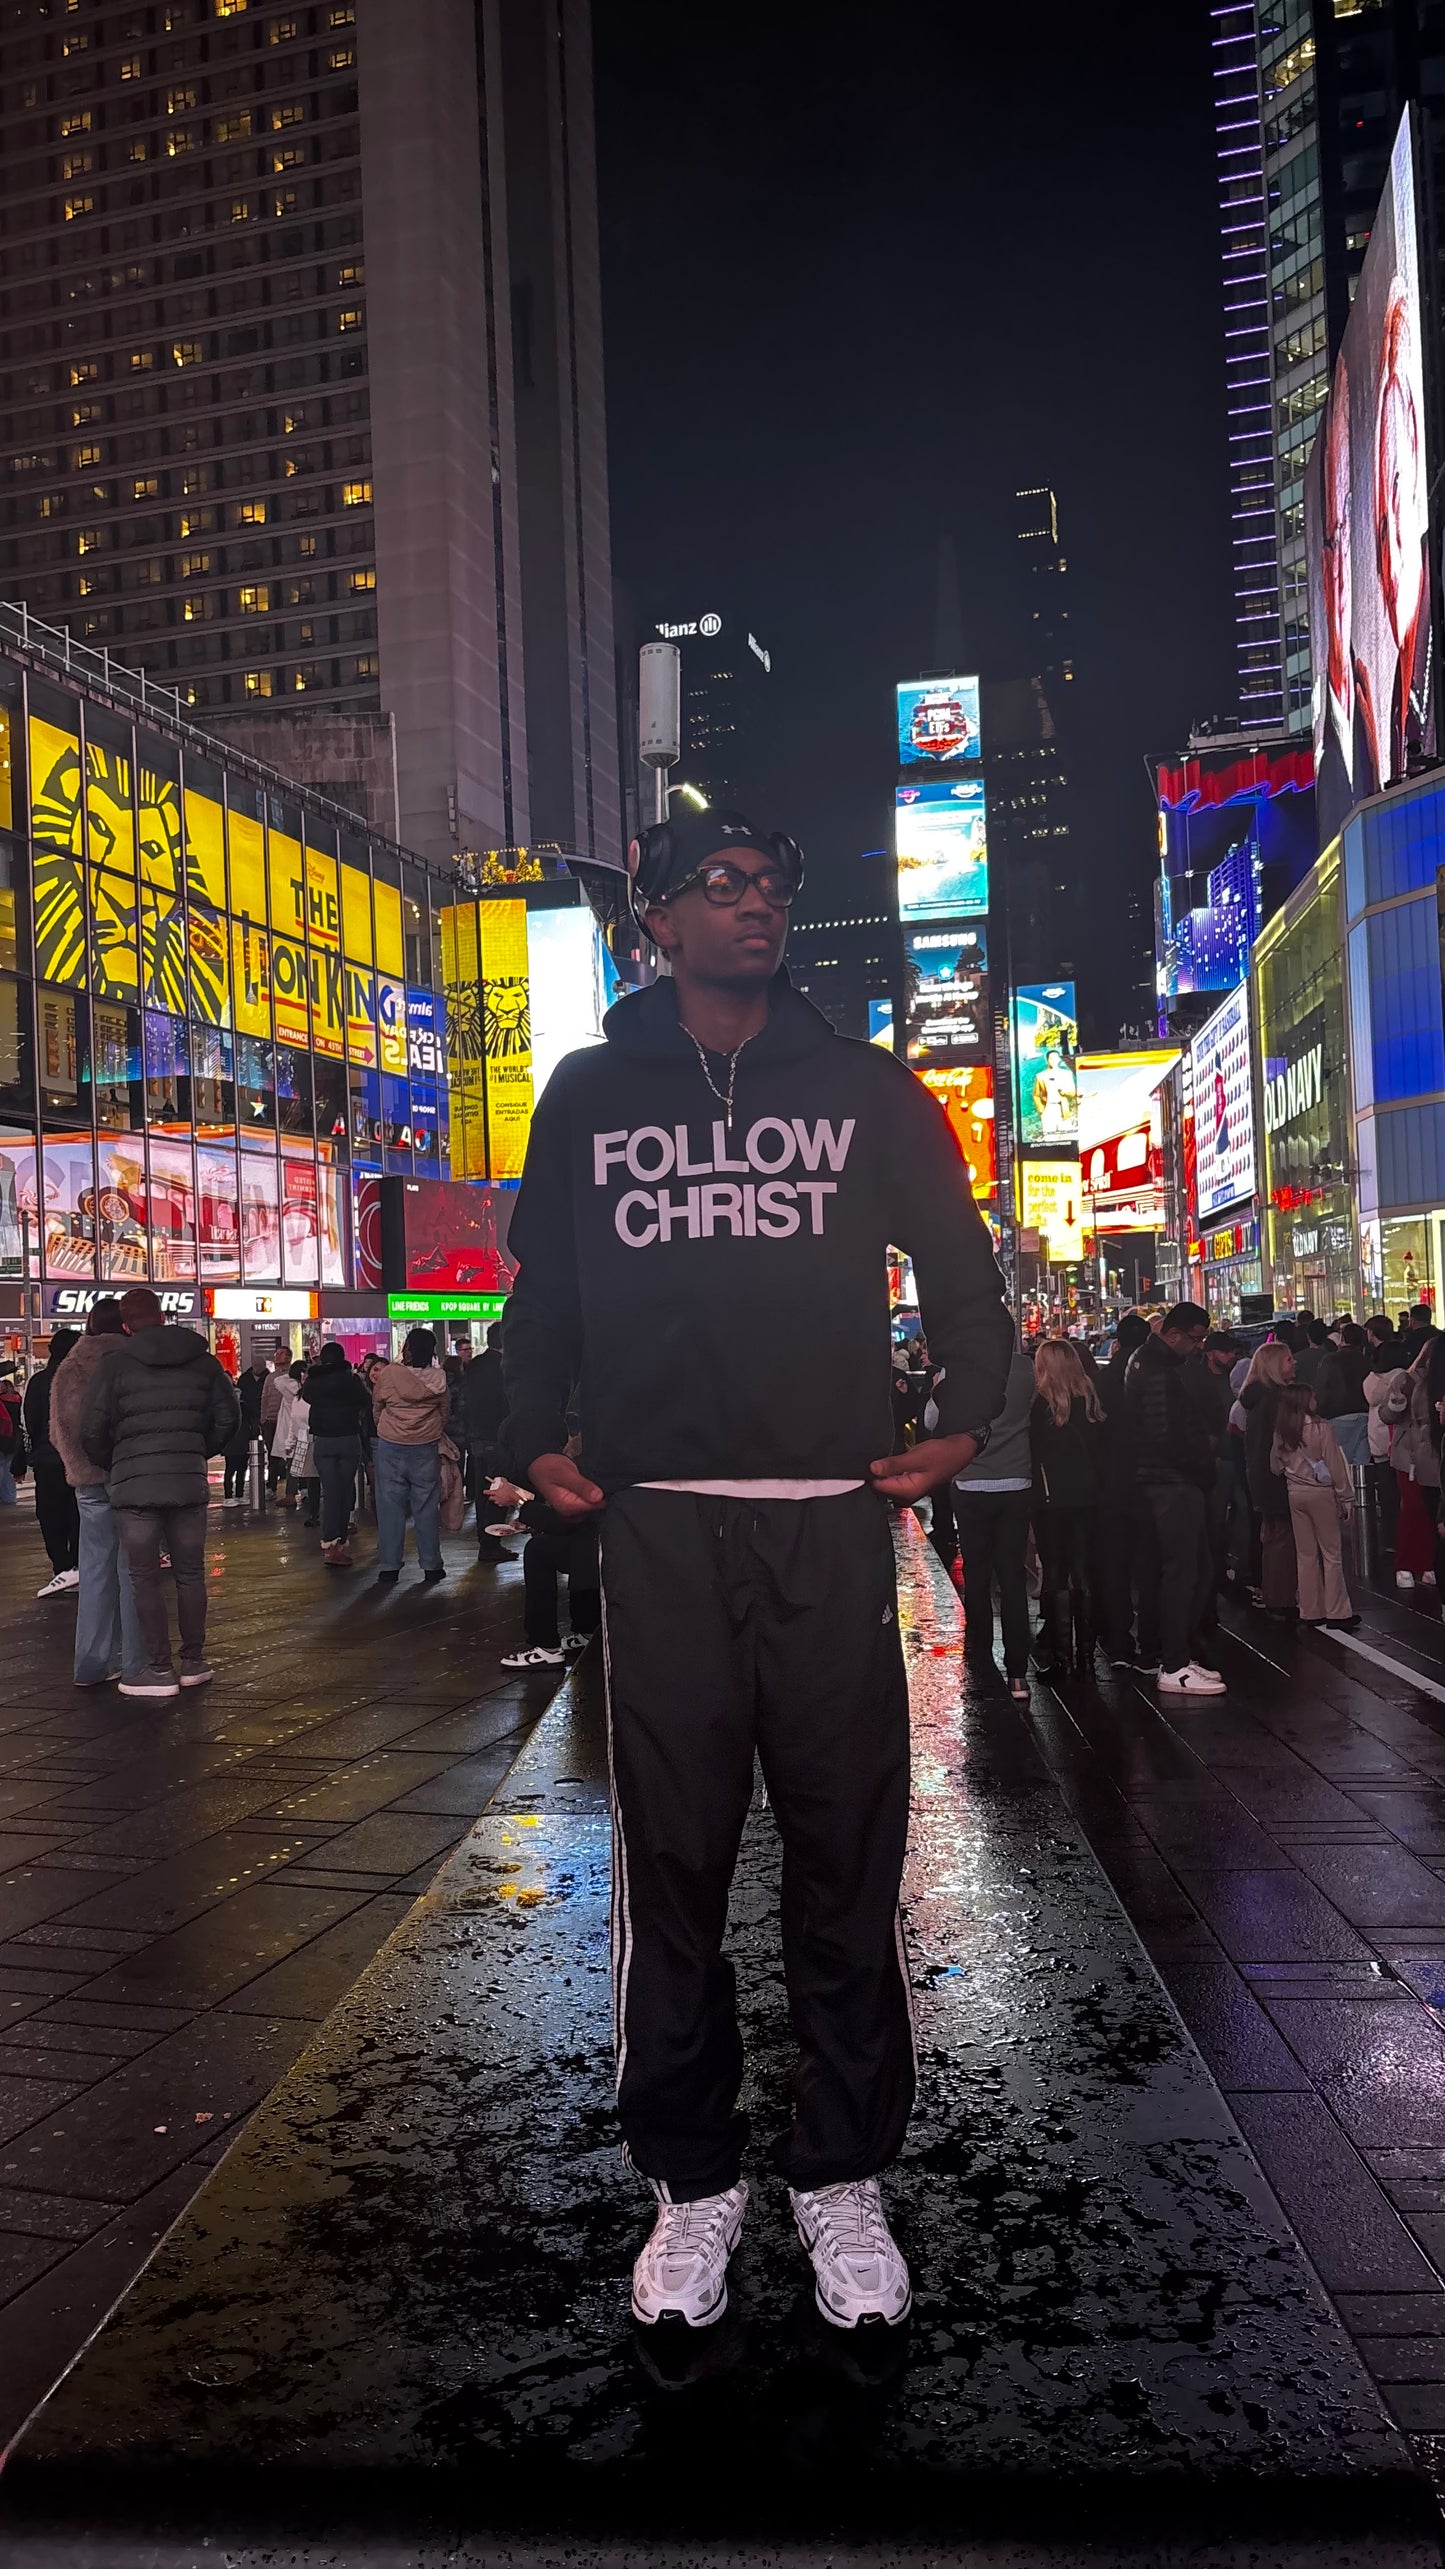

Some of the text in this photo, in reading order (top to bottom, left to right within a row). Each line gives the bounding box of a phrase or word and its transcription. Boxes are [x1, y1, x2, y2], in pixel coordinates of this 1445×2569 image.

[290, 877, 338, 932] THE
[912, 932, 977, 950] SAMSUNG
[241, 909, 321, 1006] LION
[279, 1027, 365, 1059] ENTRANCE ON 45TH STREET
[490, 1066, 502, 1074] THE
[499, 1073, 531, 1083] MUSICAL
[1264, 1043, 1322, 1135] OLD NAVY
[594, 1117, 856, 1185] FOLLOW
[1027, 1172, 1072, 1183] come in
[1027, 1184, 1056, 1197] for the
[615, 1181, 838, 1248] CHRIST
[1027, 1200, 1058, 1215] perfect
[1303, 1230, 1318, 1255] NAVY
[392, 1302, 429, 1311] LINE FRIENDS
[441, 1302, 457, 1312] KPOP
[458, 1303, 481, 1312] SQUARE
[483, 1303, 490, 1312] BY
